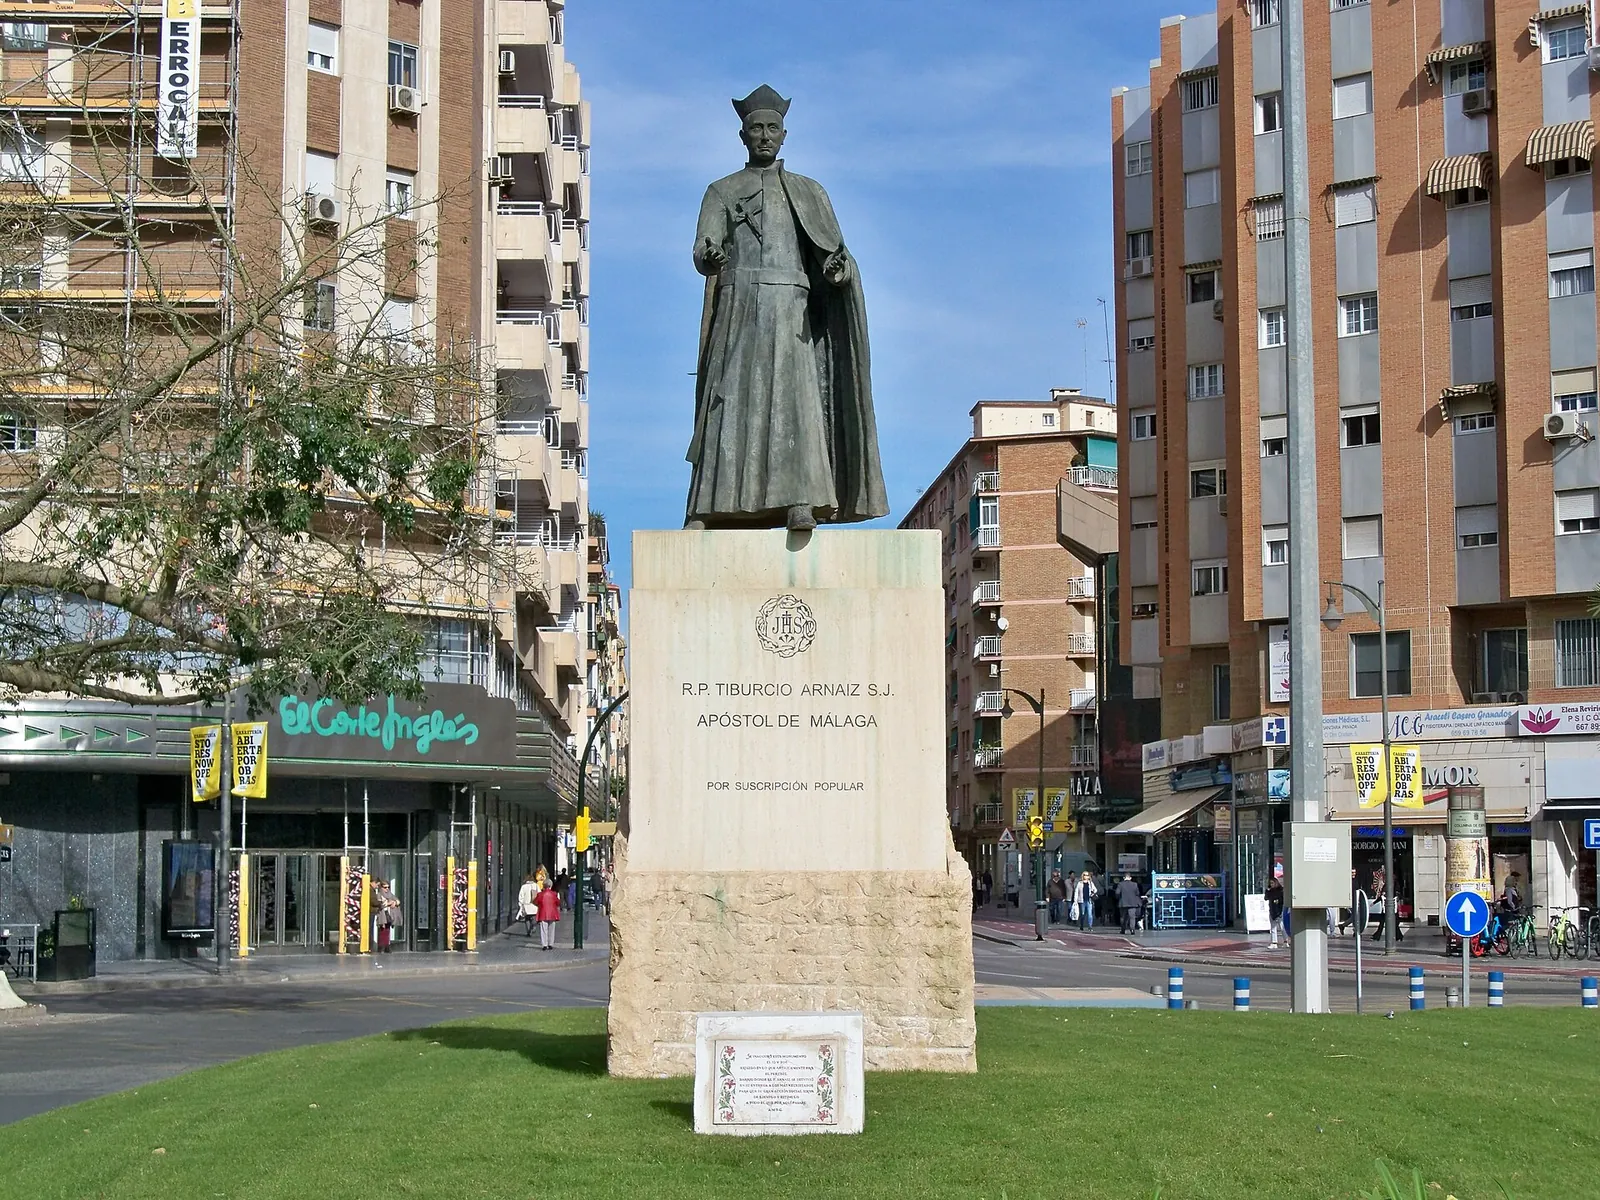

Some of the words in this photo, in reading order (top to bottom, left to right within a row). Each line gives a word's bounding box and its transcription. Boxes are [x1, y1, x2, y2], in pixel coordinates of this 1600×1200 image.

[682, 683, 710, 696] R.P.
[716, 683, 792, 696] TIBURCIO
[801, 684, 860, 696] ARNAIZ
[868, 684, 894, 696] S.J.
[1477, 710, 1512, 720] Granados
[280, 695, 309, 736] El
[311, 698, 380, 736] Corte
[382, 693, 479, 754] Inglés
[697, 712, 773, 728] APÓSTOL
[778, 714, 800, 728] DE
[810, 712, 878, 728] MÁLAGA
[194, 738, 210, 748] STO
[237, 736, 254, 745] ABI
[194, 749, 210, 758] RES
[237, 746, 262, 755] ERTA
[195, 758, 214, 768] NOW
[238, 756, 256, 765] POR
[1356, 756, 1374, 764] STO
[1394, 756, 1409, 764] ABI
[238, 766, 252, 775] OB
[1357, 764, 1375, 772] RES
[1394, 764, 1418, 774] ERTA
[196, 768, 210, 778] OPE
[1358, 772, 1380, 780] NOW
[1423, 765, 1480, 786] MOR
[239, 776, 256, 784] RAS
[1395, 774, 1412, 782] POR
[196, 779, 202, 788] N
[707, 782, 730, 791] POR
[735, 780, 808, 791] SUSCRIPCIÓN
[814, 782, 864, 791] POPULAR
[1358, 782, 1376, 790] OPE
[1396, 782, 1407, 790] OB
[1359, 790, 1366, 798] N
[1394, 790, 1414, 798] RAS
[1380, 842, 1406, 850] AANI
